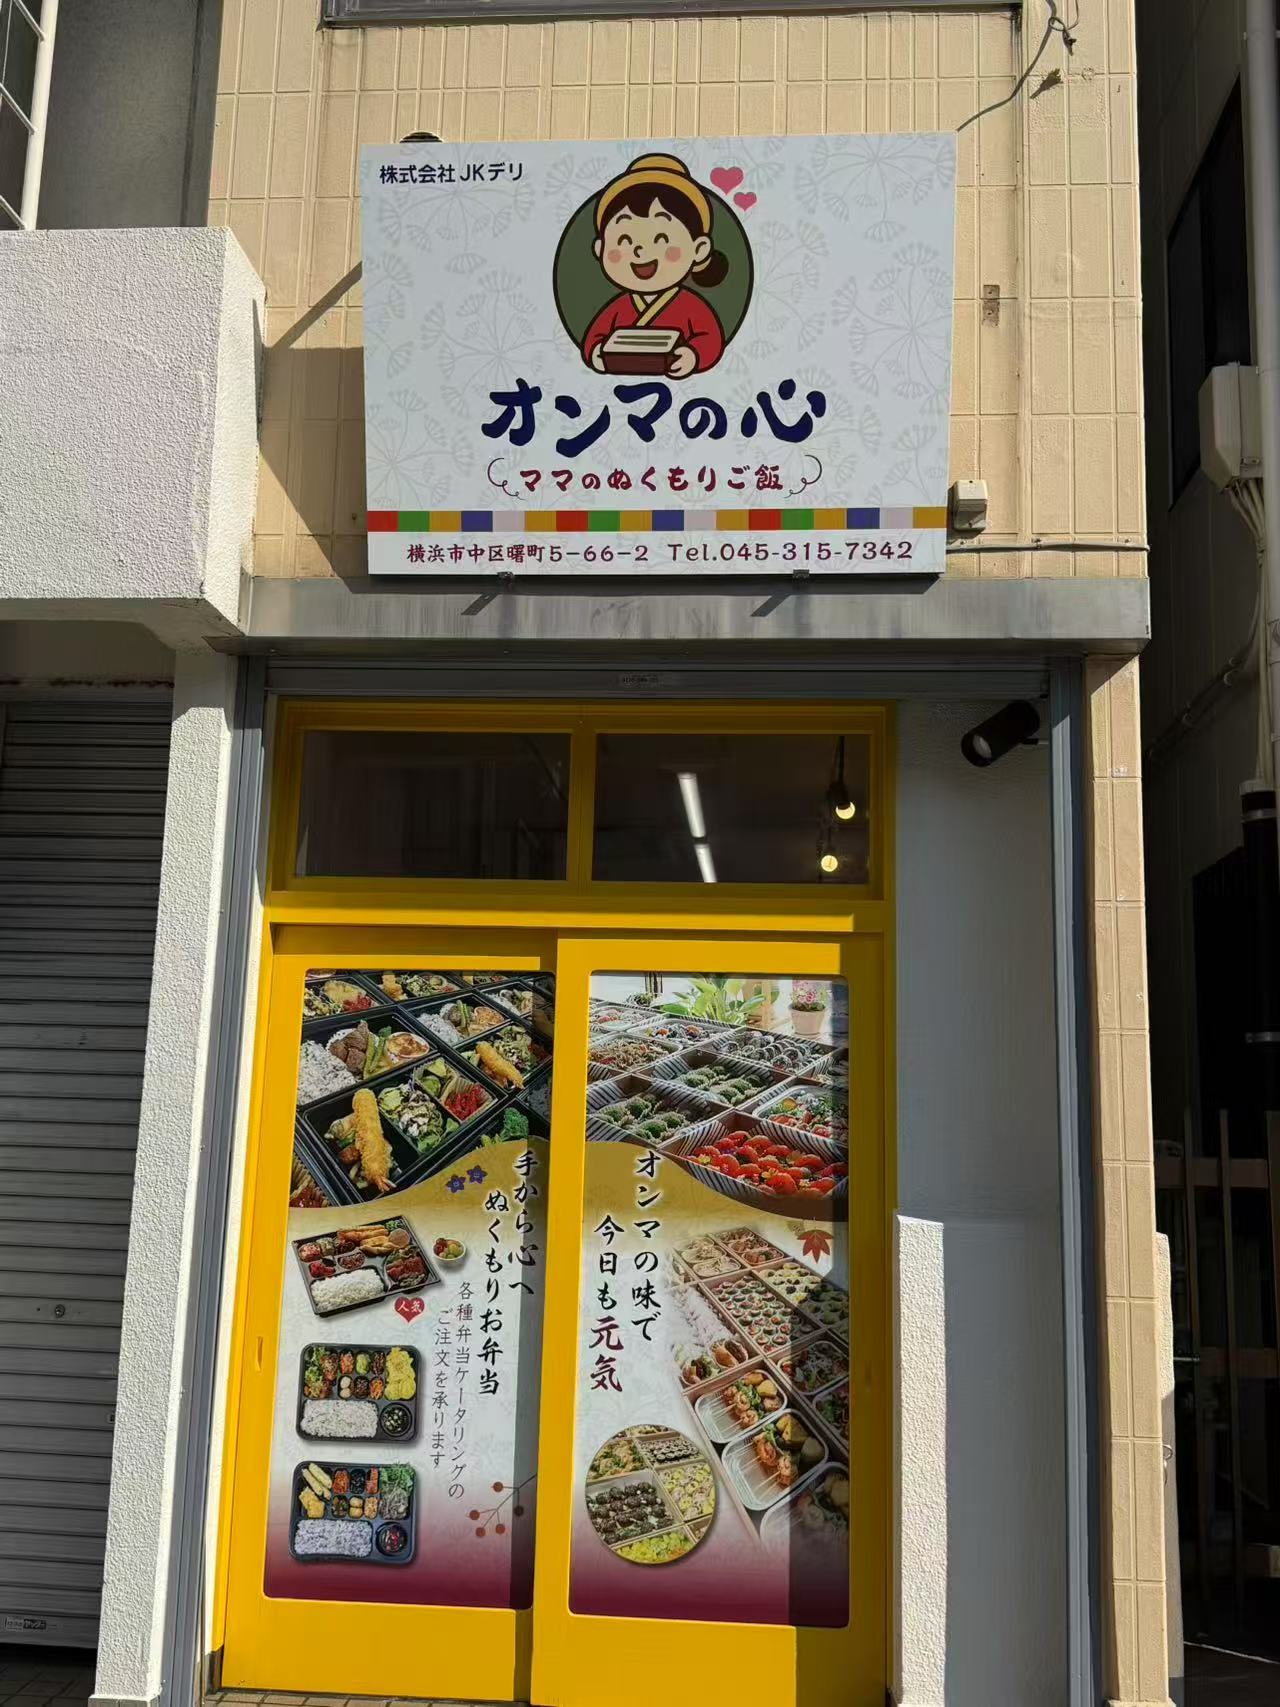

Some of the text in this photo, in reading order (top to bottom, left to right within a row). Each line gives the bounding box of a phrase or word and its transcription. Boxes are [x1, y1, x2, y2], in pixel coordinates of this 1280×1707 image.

[481, 377, 827, 458] オンマの心
[519, 464, 784, 492] ママのぬくもりご飯
[667, 541, 913, 561] Tel.045-315-7342
[477, 1189, 510, 1396] ぬくもりお弁当
[507, 1150, 539, 1295] 手から心へ
[588, 1214, 625, 1393] 今日も元気
[631, 1150, 662, 1342] オンマの味で
[429, 1307, 453, 1469] ご注文を承ります
[447, 1281, 474, 1500] 各種弁当ケータリングの
